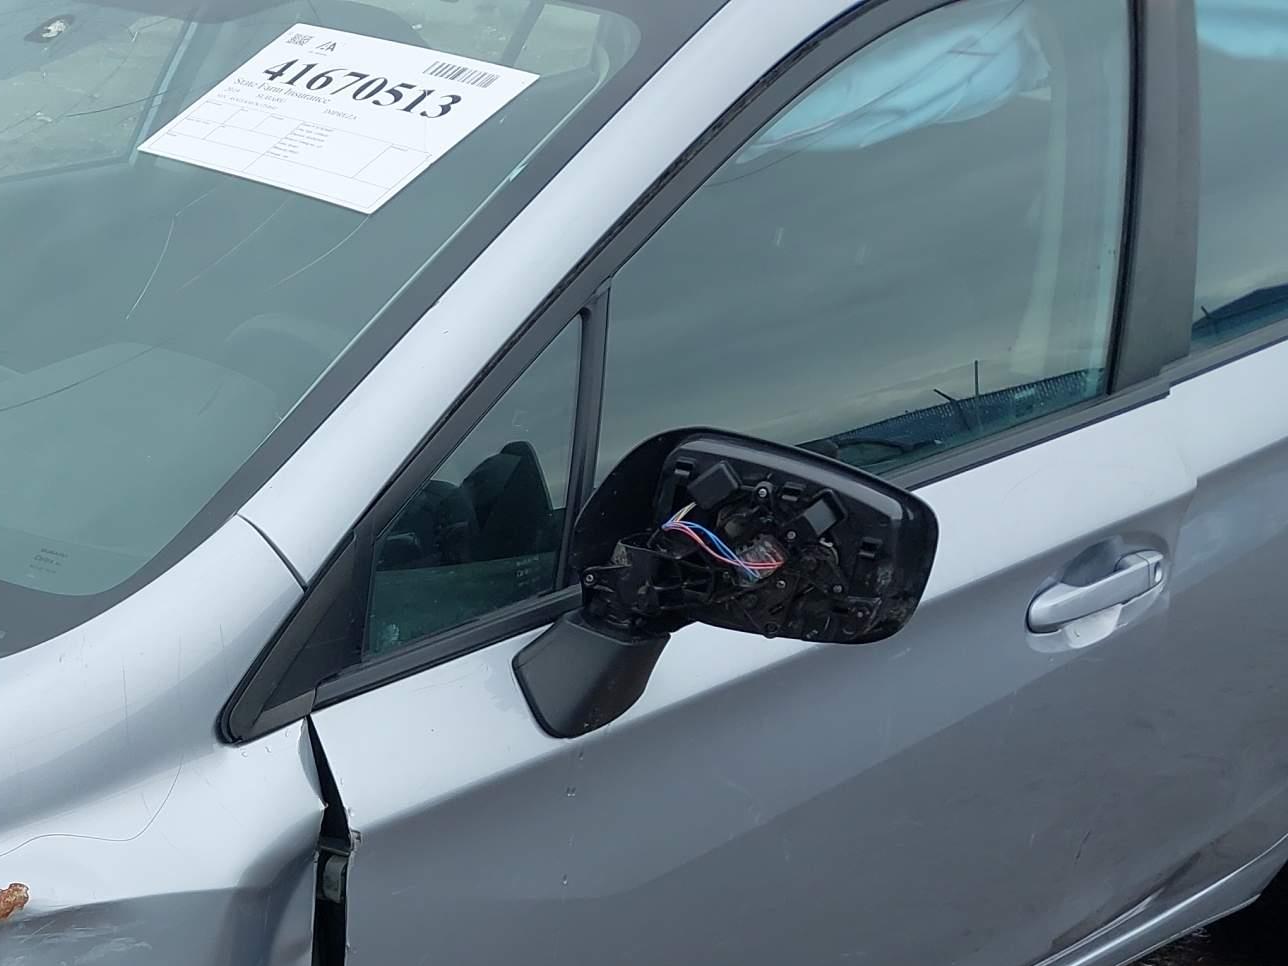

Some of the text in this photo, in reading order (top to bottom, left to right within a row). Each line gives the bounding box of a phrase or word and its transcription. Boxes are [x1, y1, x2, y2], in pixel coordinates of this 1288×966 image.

[233, 77, 258, 89] State
[258, 81, 284, 94] Farm
[284, 88, 332, 104] Insurance
[262, 58, 462, 119] 41670513
